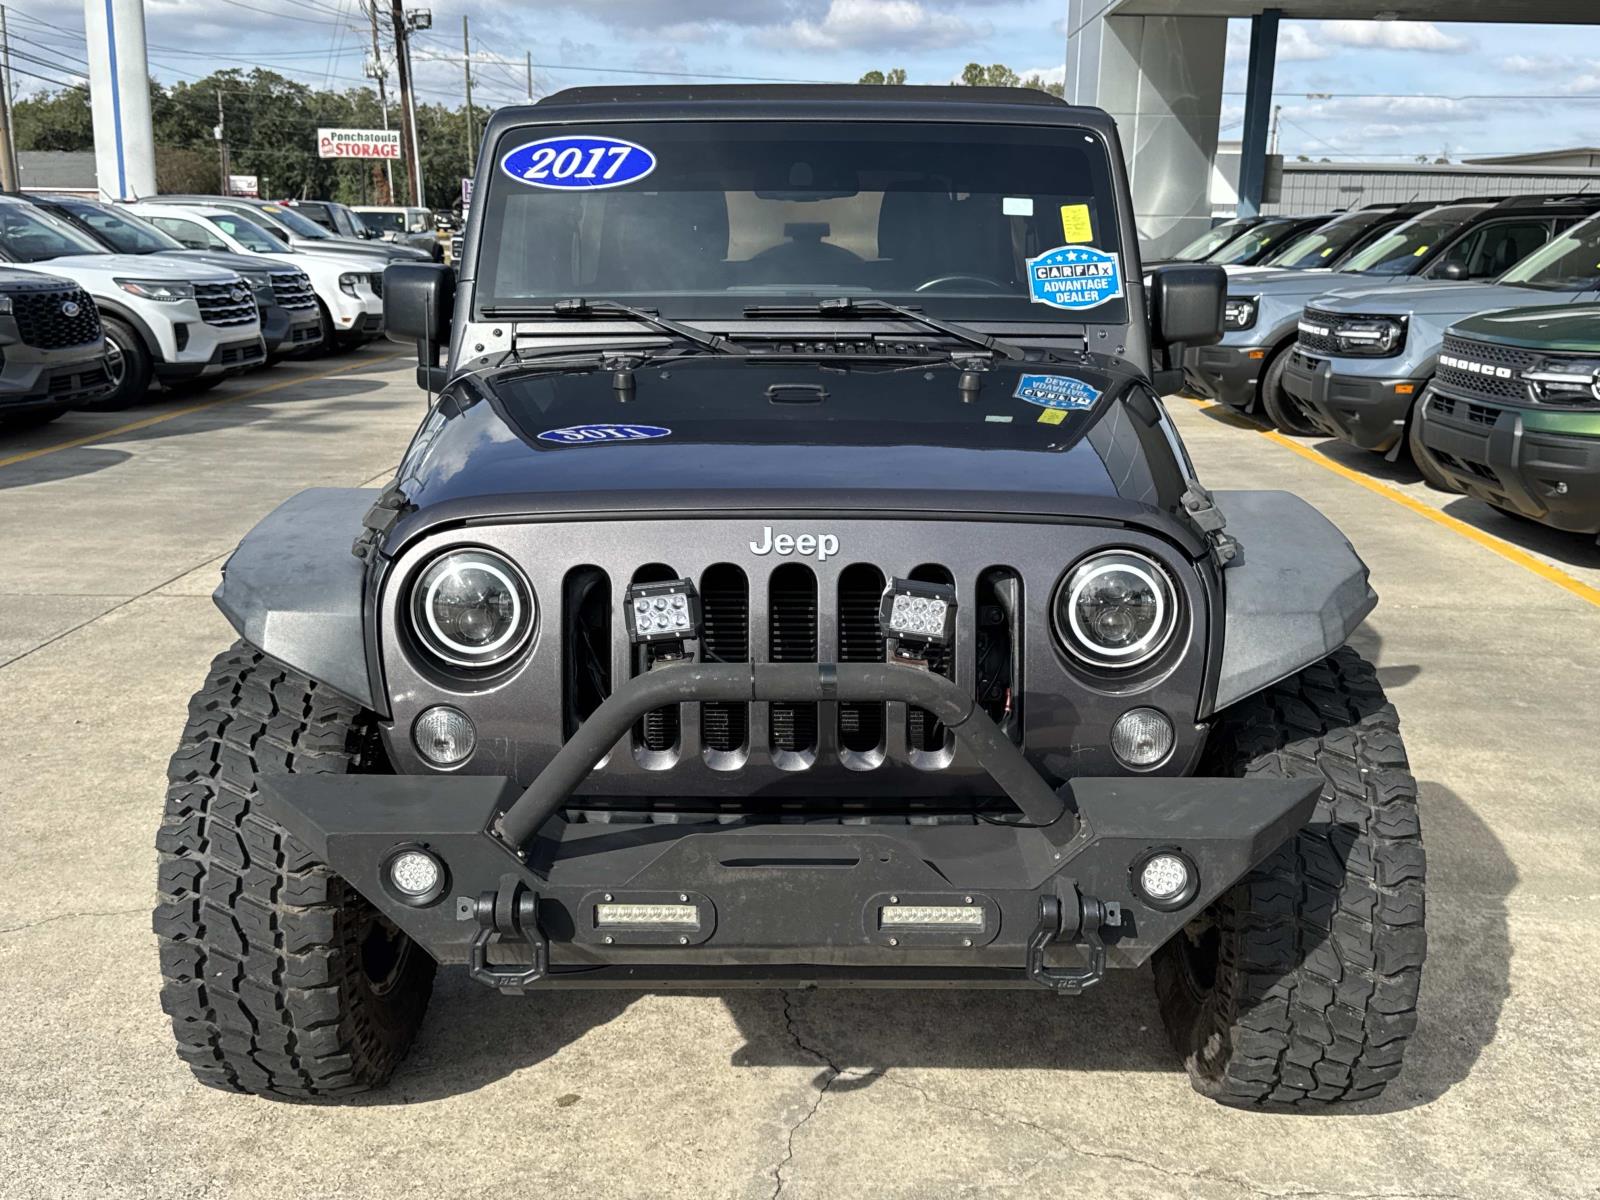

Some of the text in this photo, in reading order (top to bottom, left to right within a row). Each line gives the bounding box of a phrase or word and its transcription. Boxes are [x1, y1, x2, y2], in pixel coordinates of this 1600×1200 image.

[331, 132, 398, 143] Ponchatoula
[335, 143, 399, 157] STORAGE
[523, 146, 632, 180] 2017
[1036, 262, 1113, 279] CARFAX
[1043, 278, 1109, 293] ADVANTAGE
[1055, 290, 1100, 303] DEALER
[1440, 354, 1511, 379] BRONCO
[749, 526, 840, 561] Jeep
